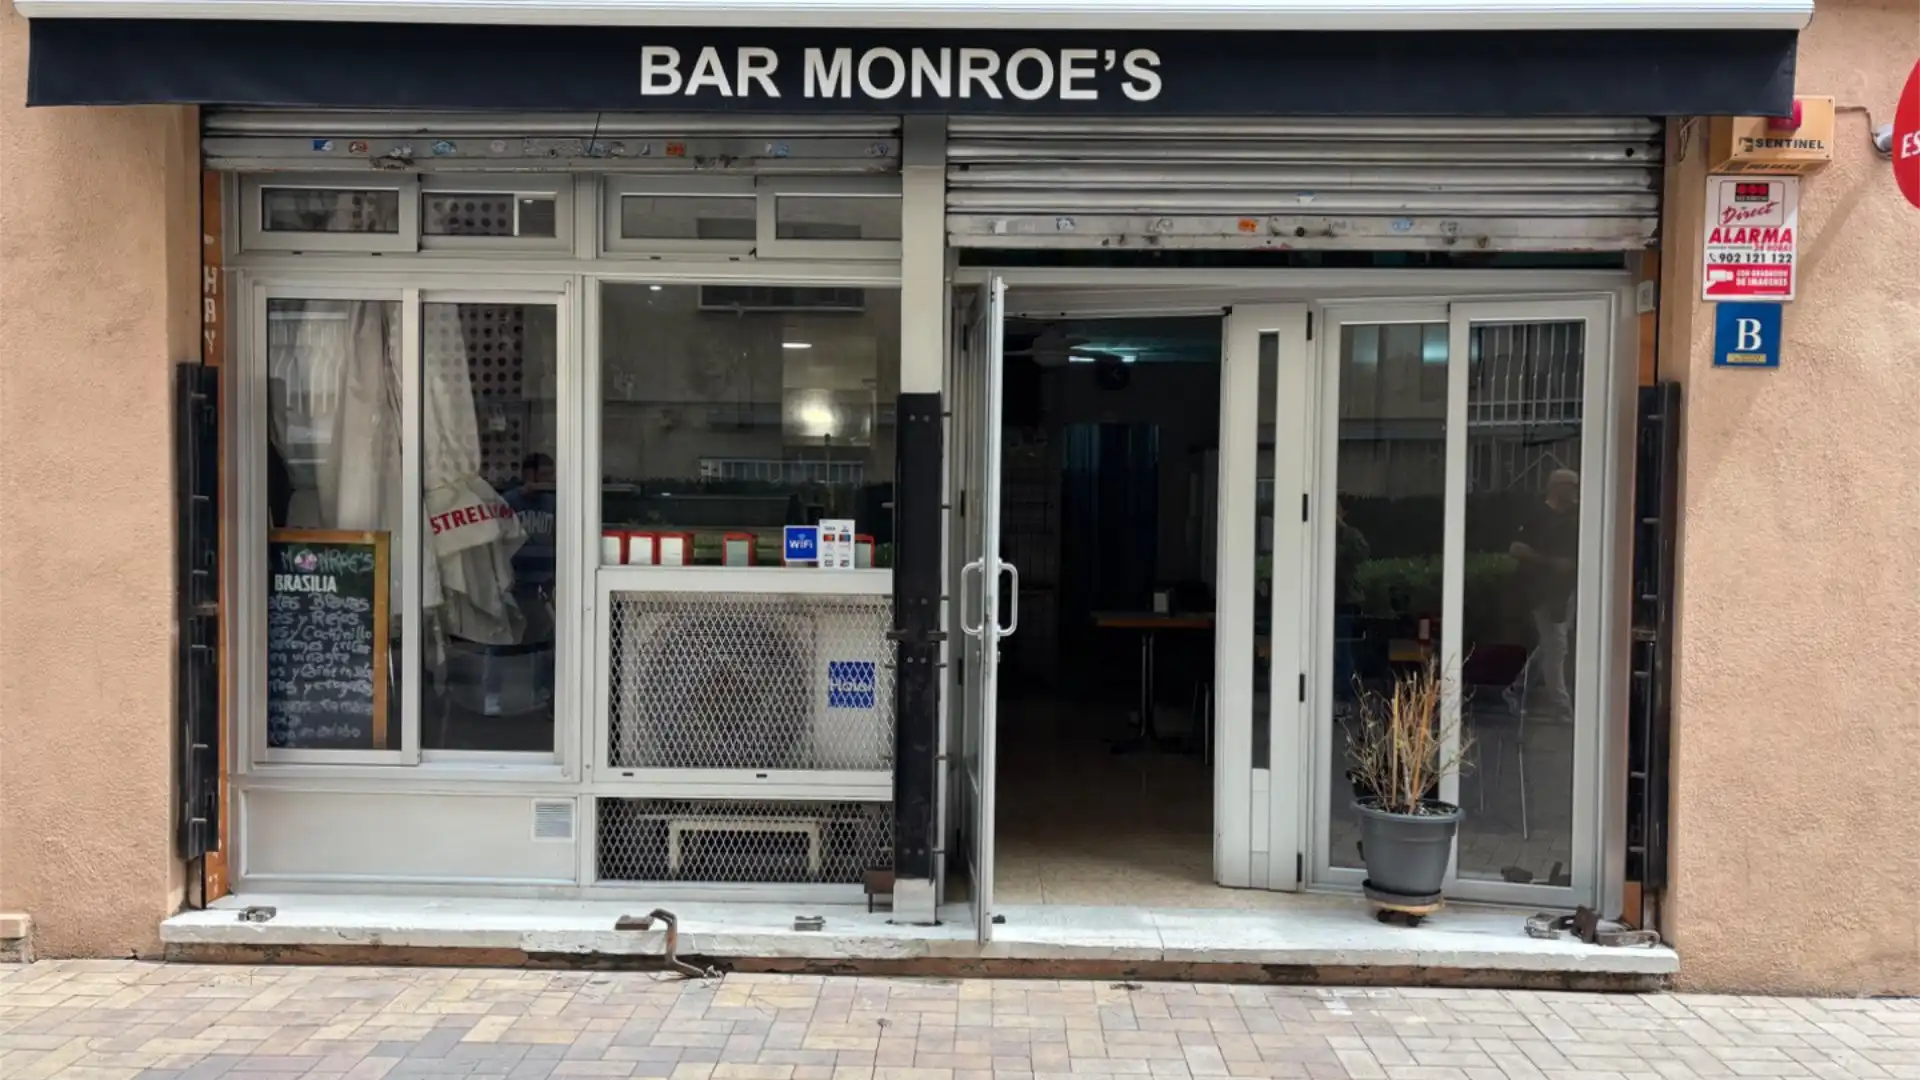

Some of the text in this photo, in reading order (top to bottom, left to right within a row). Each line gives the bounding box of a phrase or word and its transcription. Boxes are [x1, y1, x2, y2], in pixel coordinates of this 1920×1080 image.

[640, 46, 1162, 101] BAR MONROE'S
[1755, 138, 1825, 150] SENTINEL
[1720, 201, 1780, 224] Direct
[1708, 227, 1793, 244] ALARMA
[1719, 253, 1793, 263] 902 121 122
[1735, 318, 1762, 351] B
[275, 574, 337, 592] BRASILIA
